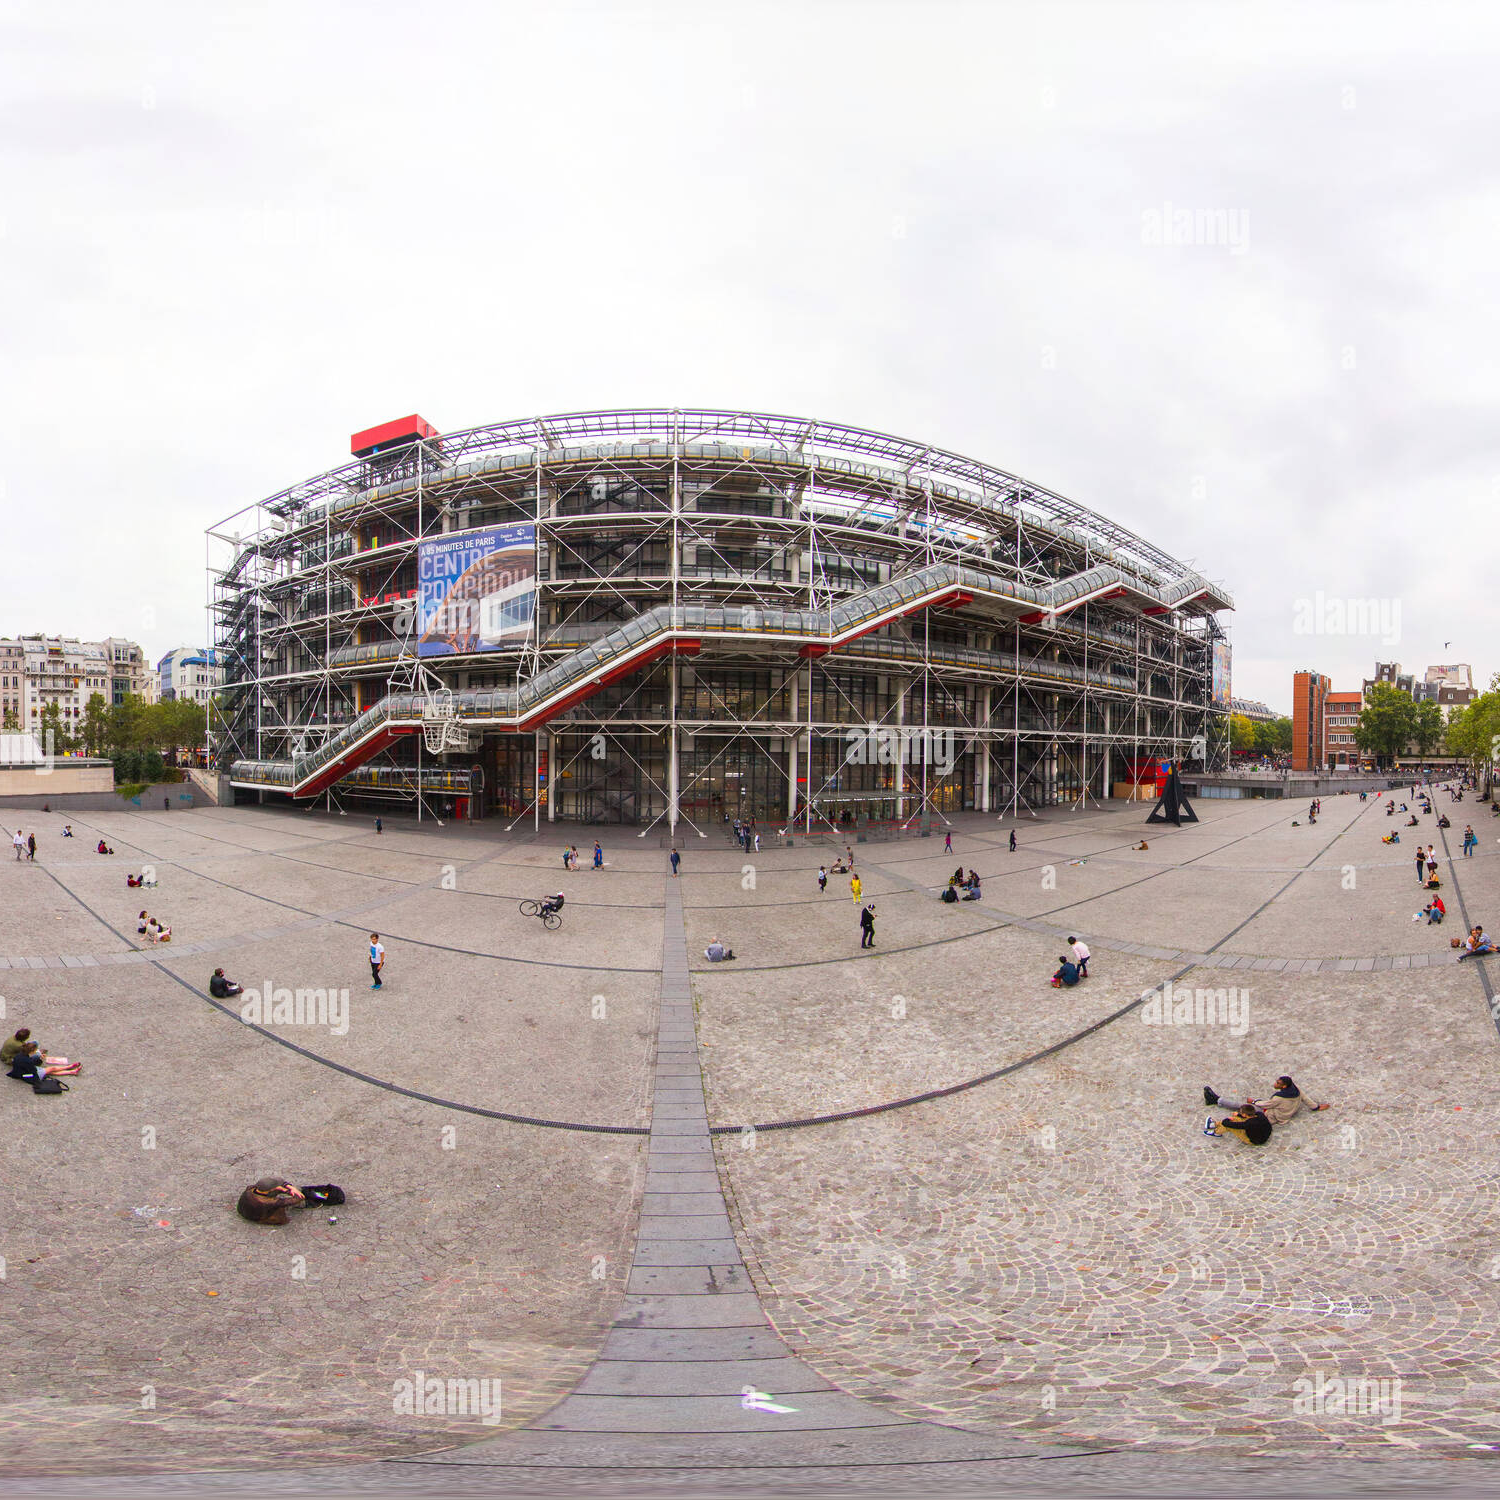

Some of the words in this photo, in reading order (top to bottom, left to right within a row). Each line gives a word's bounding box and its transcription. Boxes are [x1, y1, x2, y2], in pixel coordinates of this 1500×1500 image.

[435, 541, 464, 554] MINUTES
[465, 540, 474, 548] DE
[475, 536, 496, 547] PARIS
[420, 546, 496, 580] CENTRE
[420, 567, 528, 605] POMPIDOU
